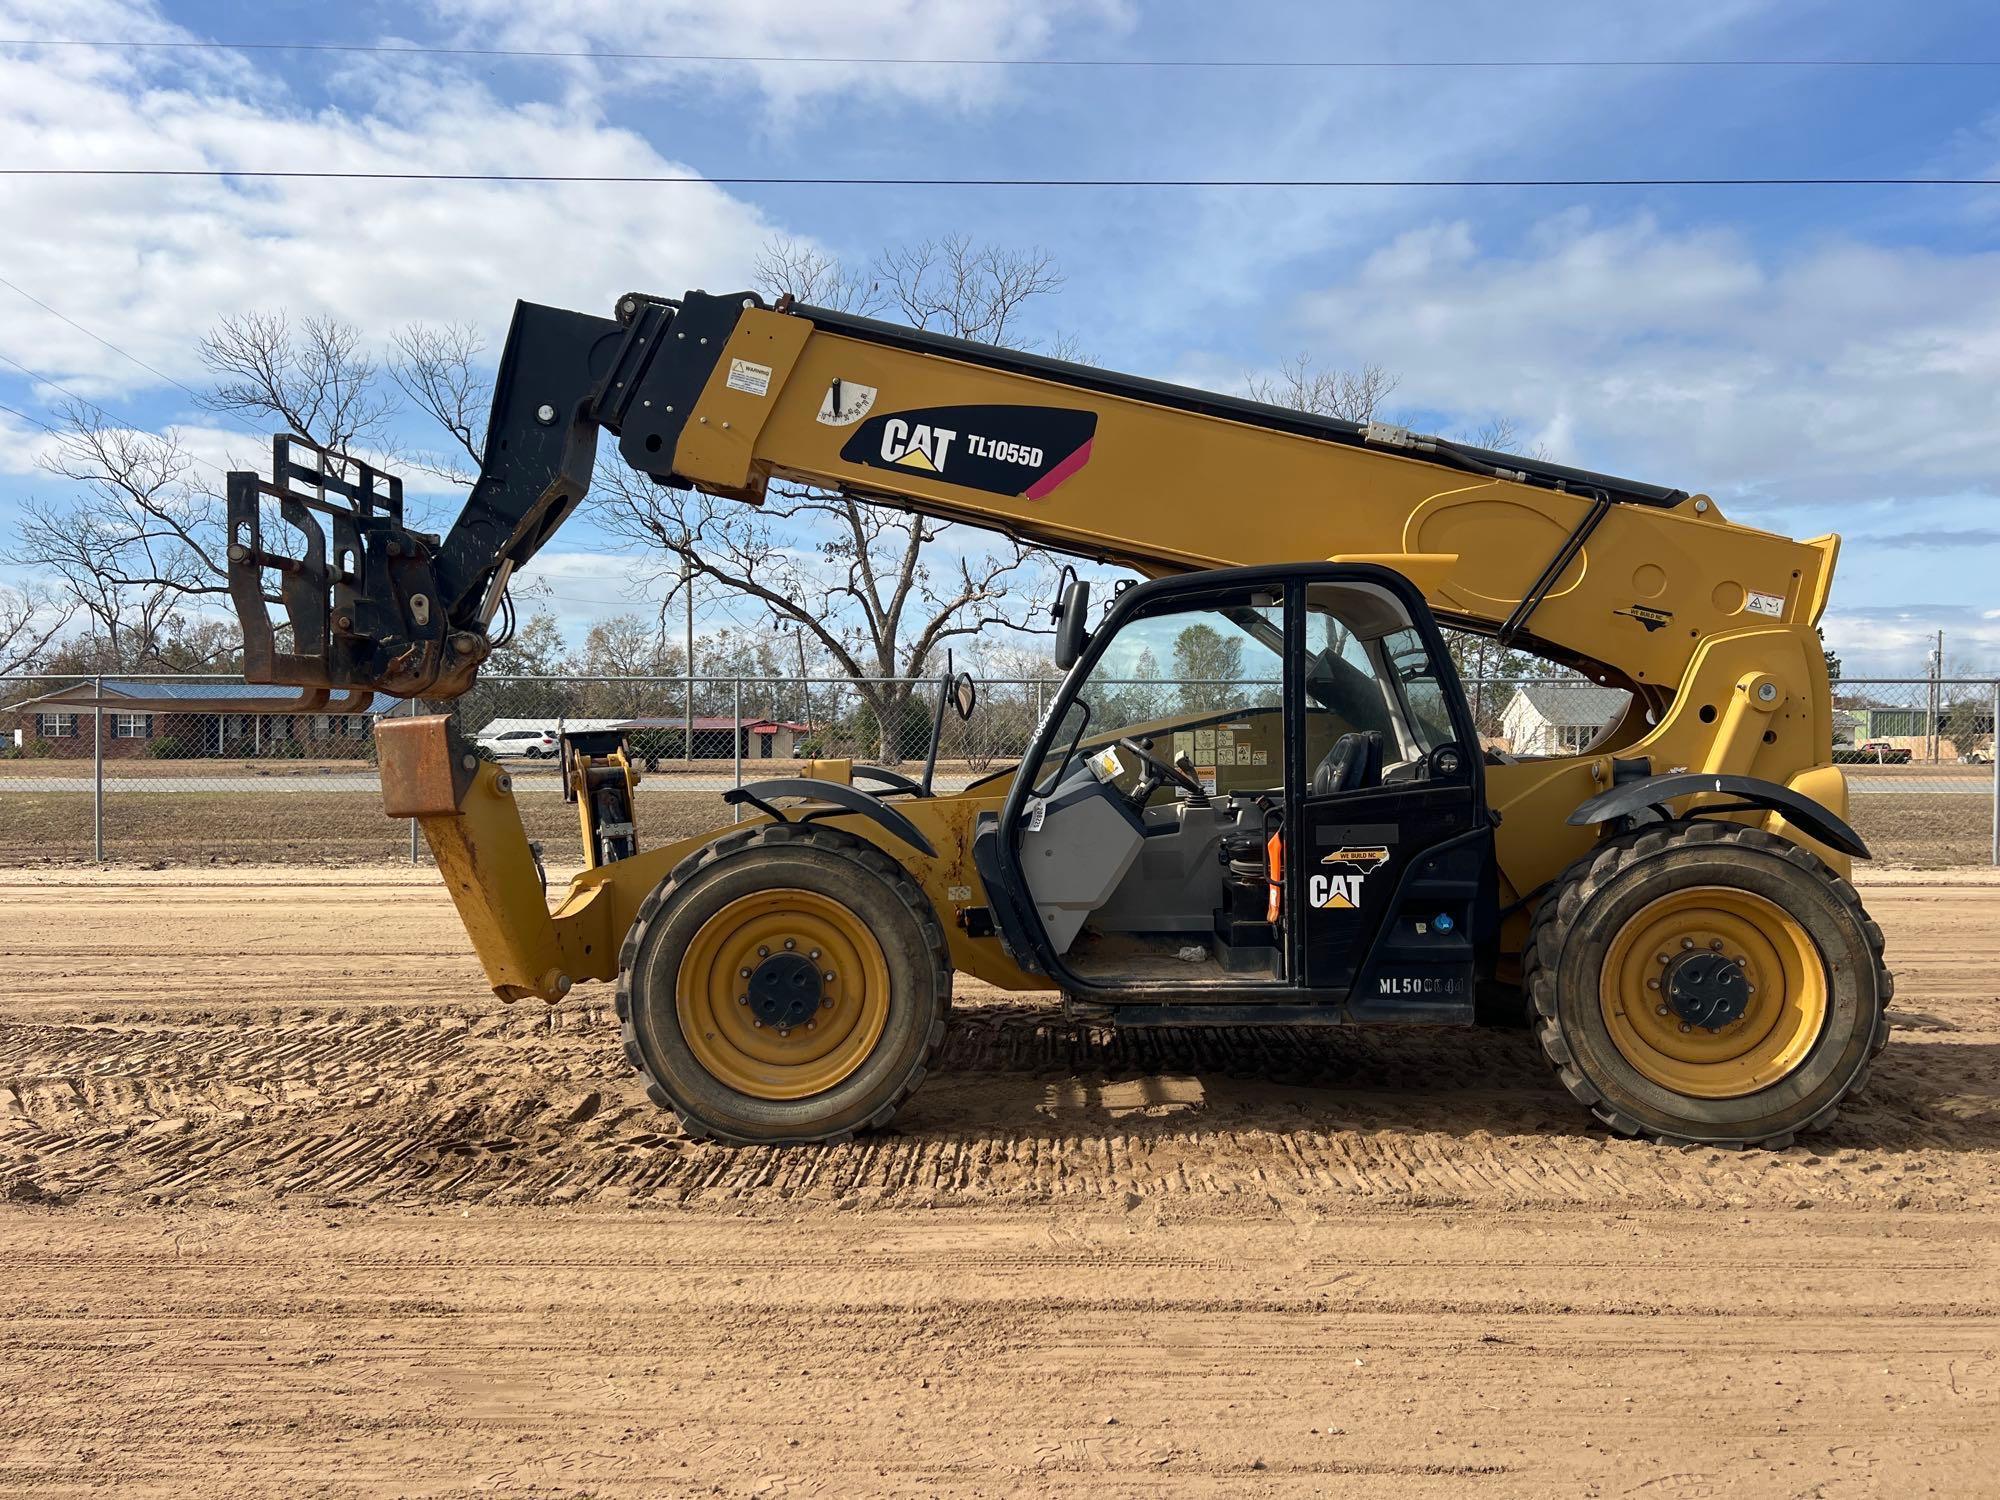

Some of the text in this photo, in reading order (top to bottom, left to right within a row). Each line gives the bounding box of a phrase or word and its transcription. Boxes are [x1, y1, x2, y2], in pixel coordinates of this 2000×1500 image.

[881, 418, 957, 473] CAT
[968, 434, 1043, 468] TL1055D
[1310, 875, 1364, 908] CAT
